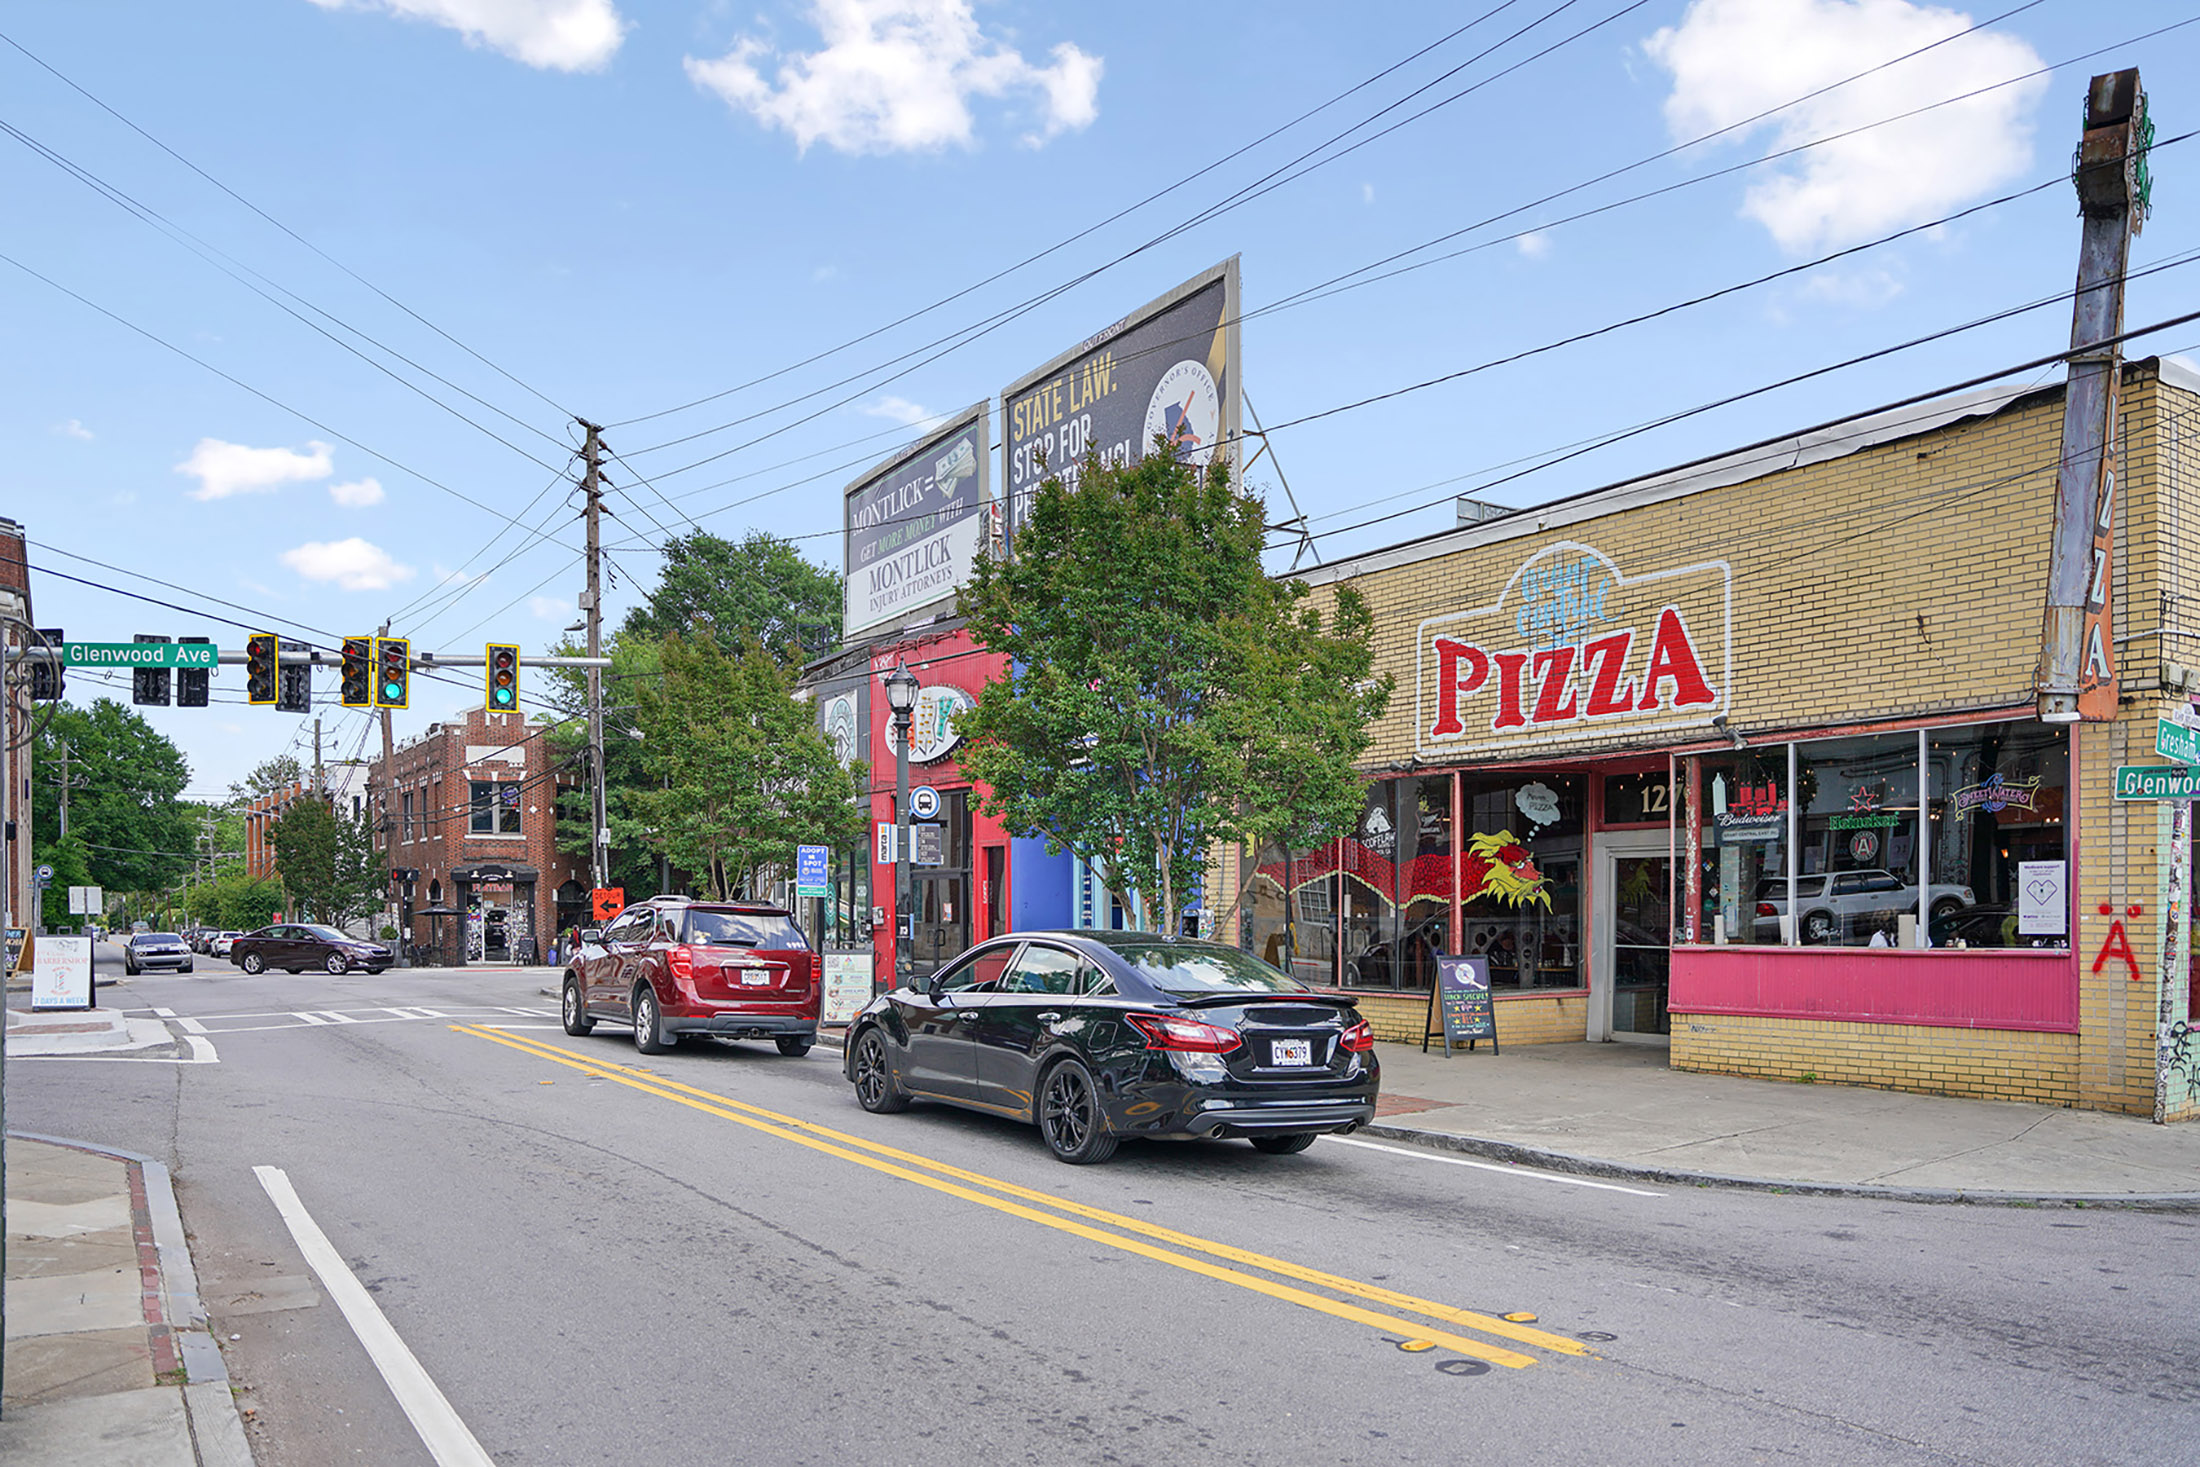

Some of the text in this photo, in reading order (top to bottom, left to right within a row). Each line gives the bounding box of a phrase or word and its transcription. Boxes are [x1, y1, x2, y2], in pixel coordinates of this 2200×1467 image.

[1013, 351, 1118, 443] STATE LAW:
[1191, 367, 1214, 401] OFFICE
[1013, 413, 1092, 485] STOP FOR
[852, 476, 925, 537] MONTLICK
[860, 496, 964, 563] GET MORE MONEY WITH
[869, 533, 953, 596] MONTLICK
[869, 565, 953, 613] INJURY ATTORNEYS
[1521, 556, 1601, 603] Grant
[1516, 577, 1622, 641] Central
[70, 645, 211, 662] Glenwood Ave
[1431, 606, 1717, 738] PIZZA
[2161, 727, 2196, 760] Gresham
[1717, 812, 1783, 827] Budweiser
[1829, 813, 1899, 831] Heineken
